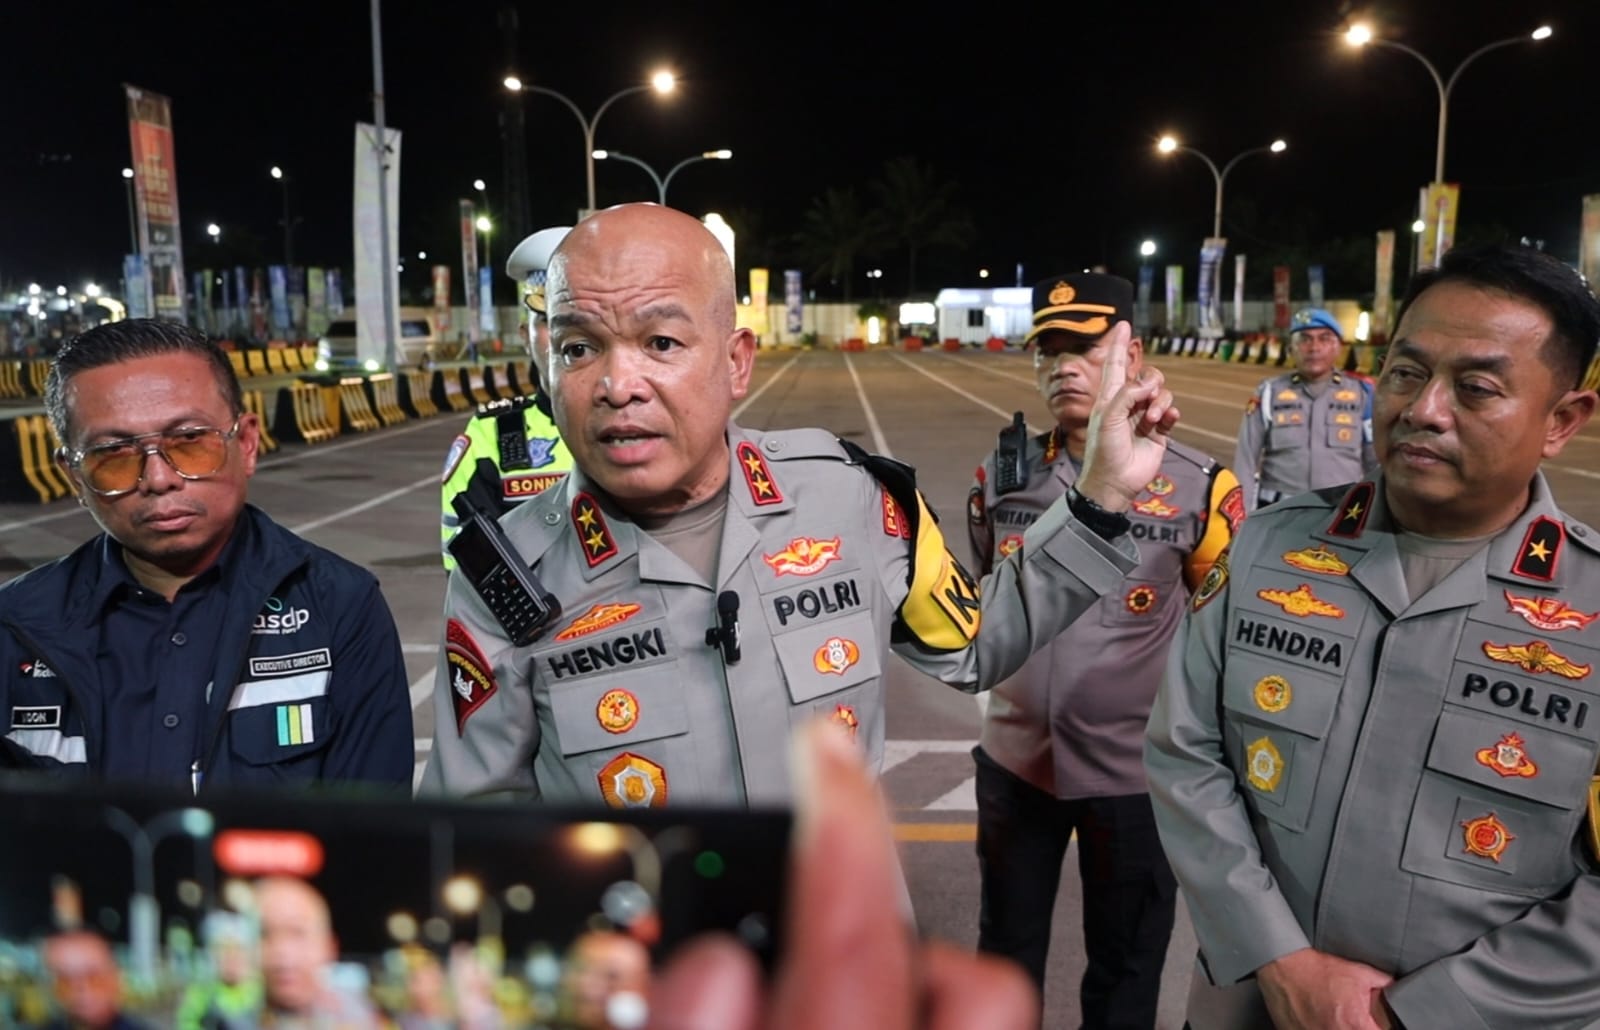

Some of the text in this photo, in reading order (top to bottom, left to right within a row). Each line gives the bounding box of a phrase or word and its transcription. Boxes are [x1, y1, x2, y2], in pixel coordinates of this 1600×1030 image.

[511, 476, 562, 493] SONN
[1131, 522, 1178, 543] OLRI
[253, 605, 310, 631] asdp
[773, 579, 861, 627] POLRI
[547, 627, 667, 679] HENGKI
[1236, 618, 1342, 668] HENDRA
[254, 653, 327, 672] EXECUTIVE DIRECTOR
[1461, 672, 1589, 730] POLRI
